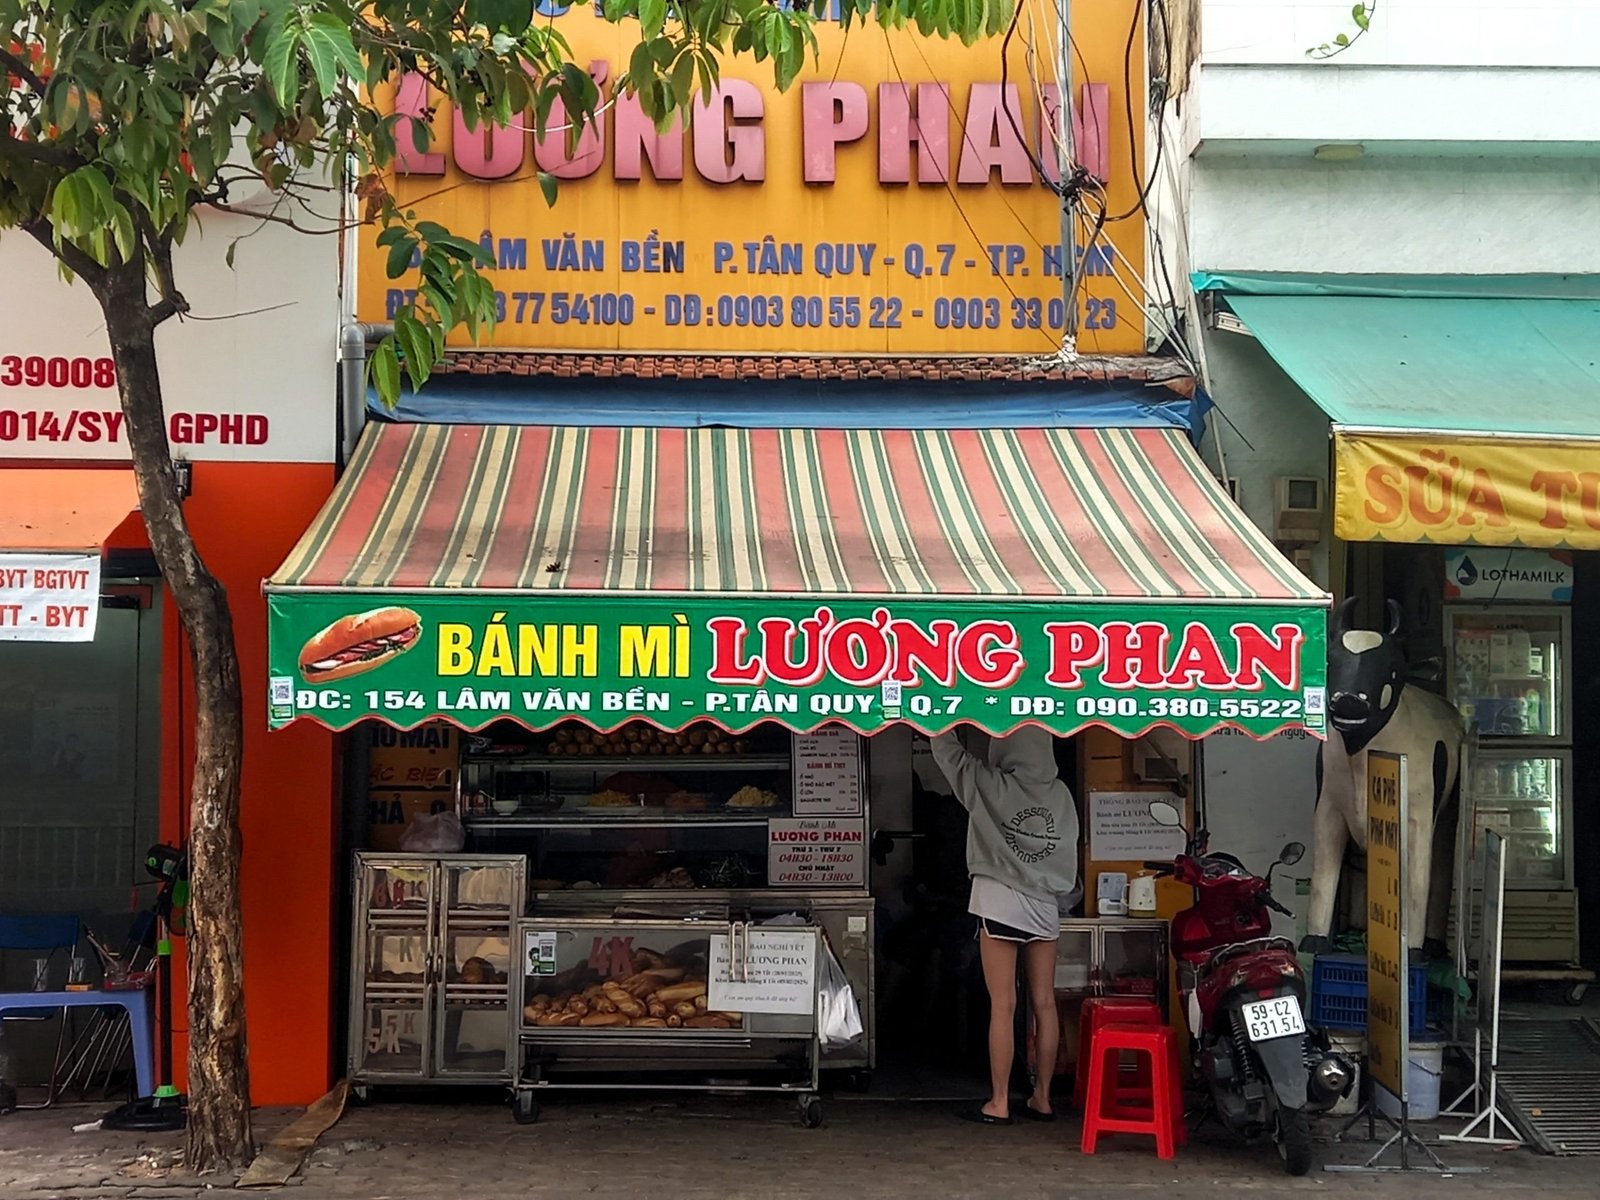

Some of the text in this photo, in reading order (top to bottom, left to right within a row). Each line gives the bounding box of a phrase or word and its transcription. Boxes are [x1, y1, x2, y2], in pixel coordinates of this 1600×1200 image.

[802, 82, 1110, 186] PHAN
[542, 232, 604, 272] VĂN
[621, 229, 685, 274] BỀN
[814, 243, 876, 277] QUY
[990, 244, 1029, 277] TP.
[934, 298, 1001, 329] 0903
[1364, 449, 1510, 527] SỮA
[34, 569, 90, 590] BGTVT
[1482, 569, 1565, 584] LOTHAMILK
[46, 605, 89, 627] BYT
[437, 606, 1304, 690] BÁNH MÌ LƯƠNG PHAN
[295, 689, 352, 710] ĐC:
[364, 691, 426, 710] 154
[437, 687, 511, 711] LÂM
[522, 687, 591, 711] VĂN
[602, 686, 670, 712] BỀN
[706, 688, 798, 713] P.TÂN
[810, 693, 875, 714] QUY
[910, 695, 963, 716] Q.7
[1010, 696, 1065, 717] DĐ:
[1076, 696, 1302, 719] 090.380.5522
[824, 831, 861, 842] PHAN
[1250, 1017, 1300, 1037] 631.54
